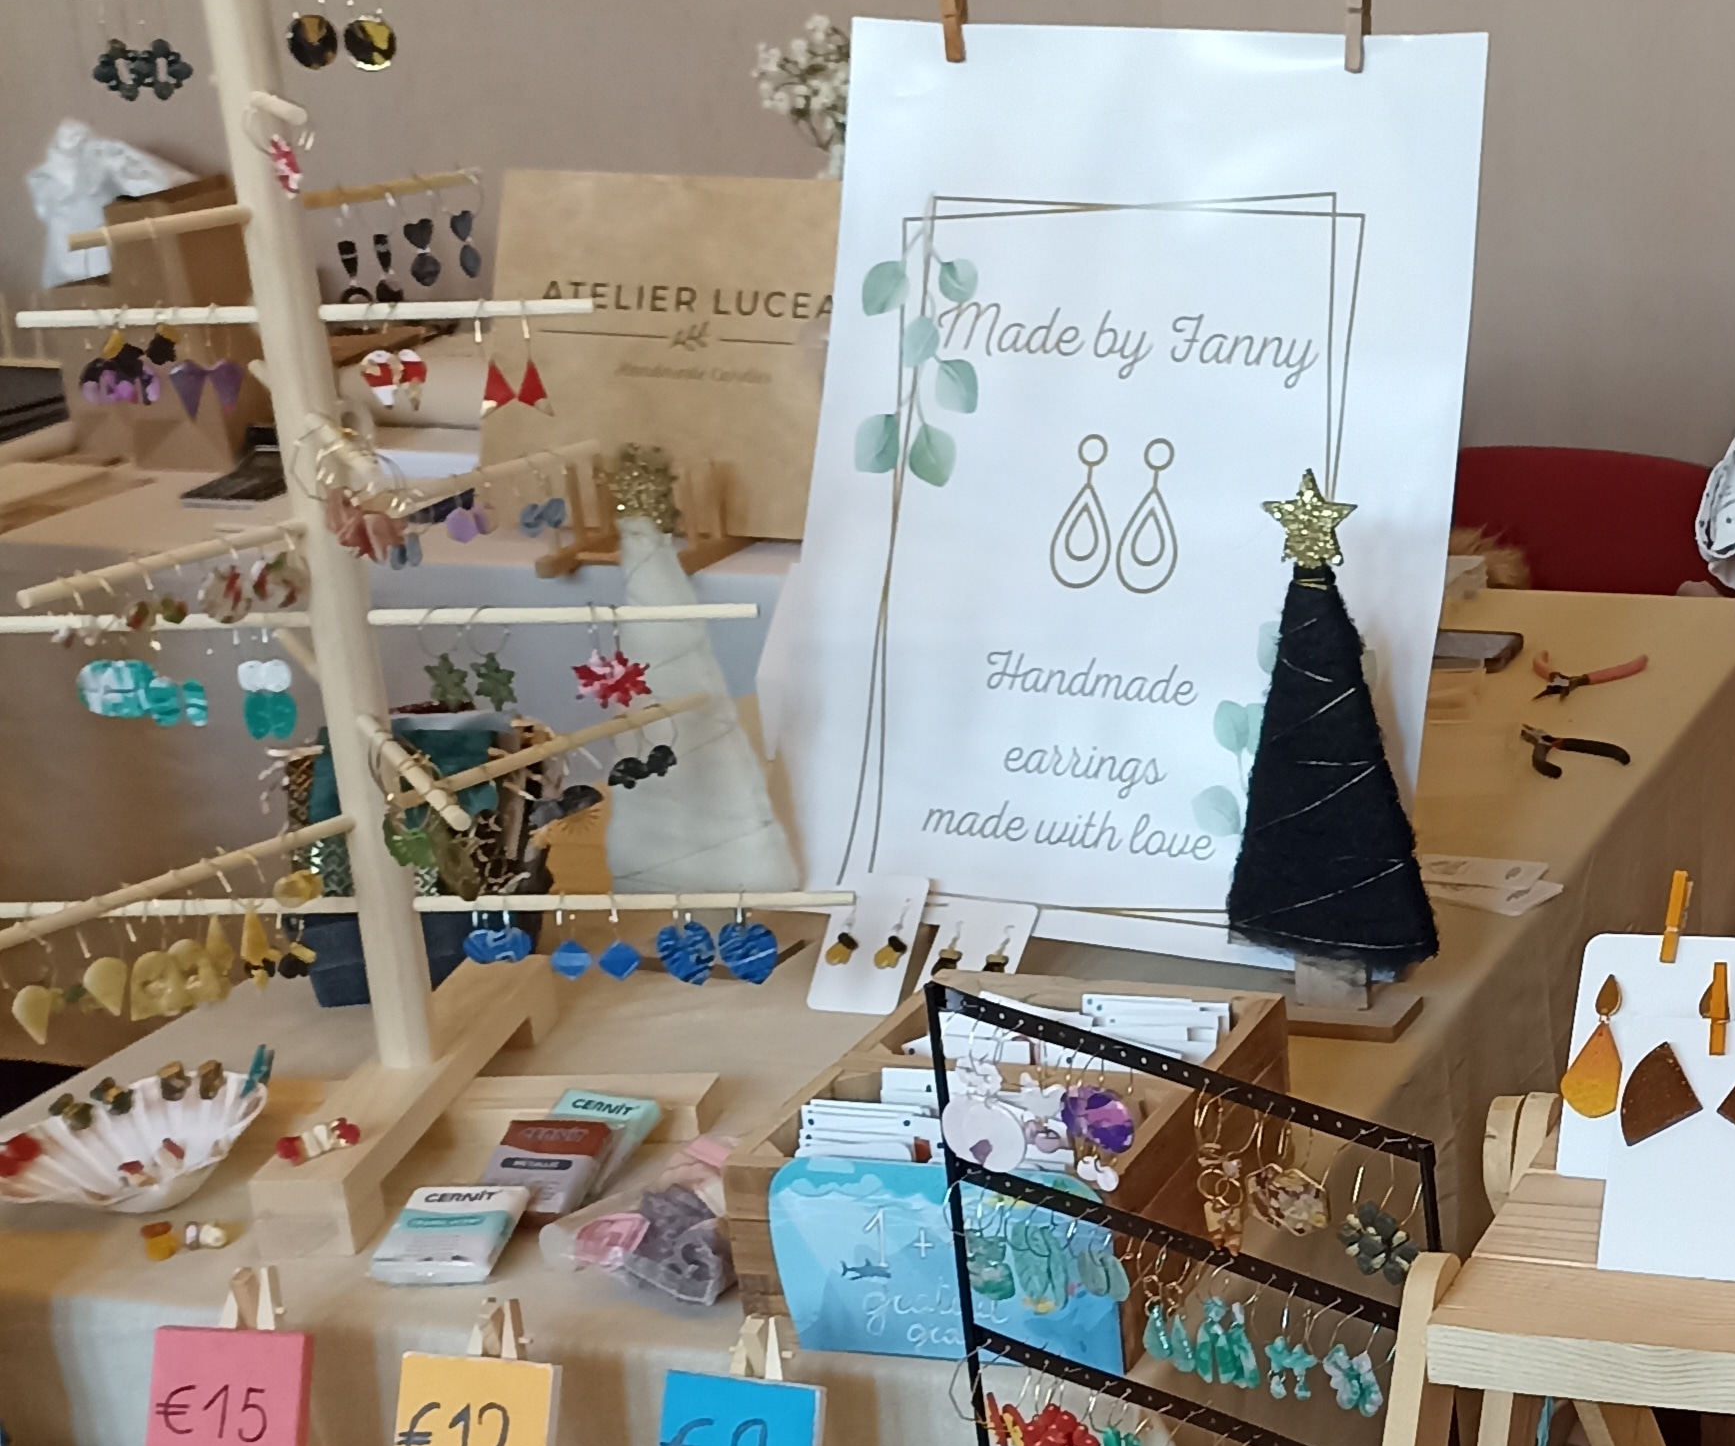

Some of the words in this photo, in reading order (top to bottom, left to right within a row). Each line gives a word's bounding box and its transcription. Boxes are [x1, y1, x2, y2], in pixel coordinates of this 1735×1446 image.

[542, 280, 697, 313] ATELIER
[938, 301, 1086, 356] Made
[1094, 309, 1154, 380] by
[1171, 312, 1319, 390] Fanny
[986, 649, 1198, 706] Handmade
[1003, 744, 1168, 800] earrings
[921, 800, 1029, 842] made
[1033, 810, 1123, 852] with
[1128, 812, 1216, 861] love
[156, 1384, 268, 1443] €15
